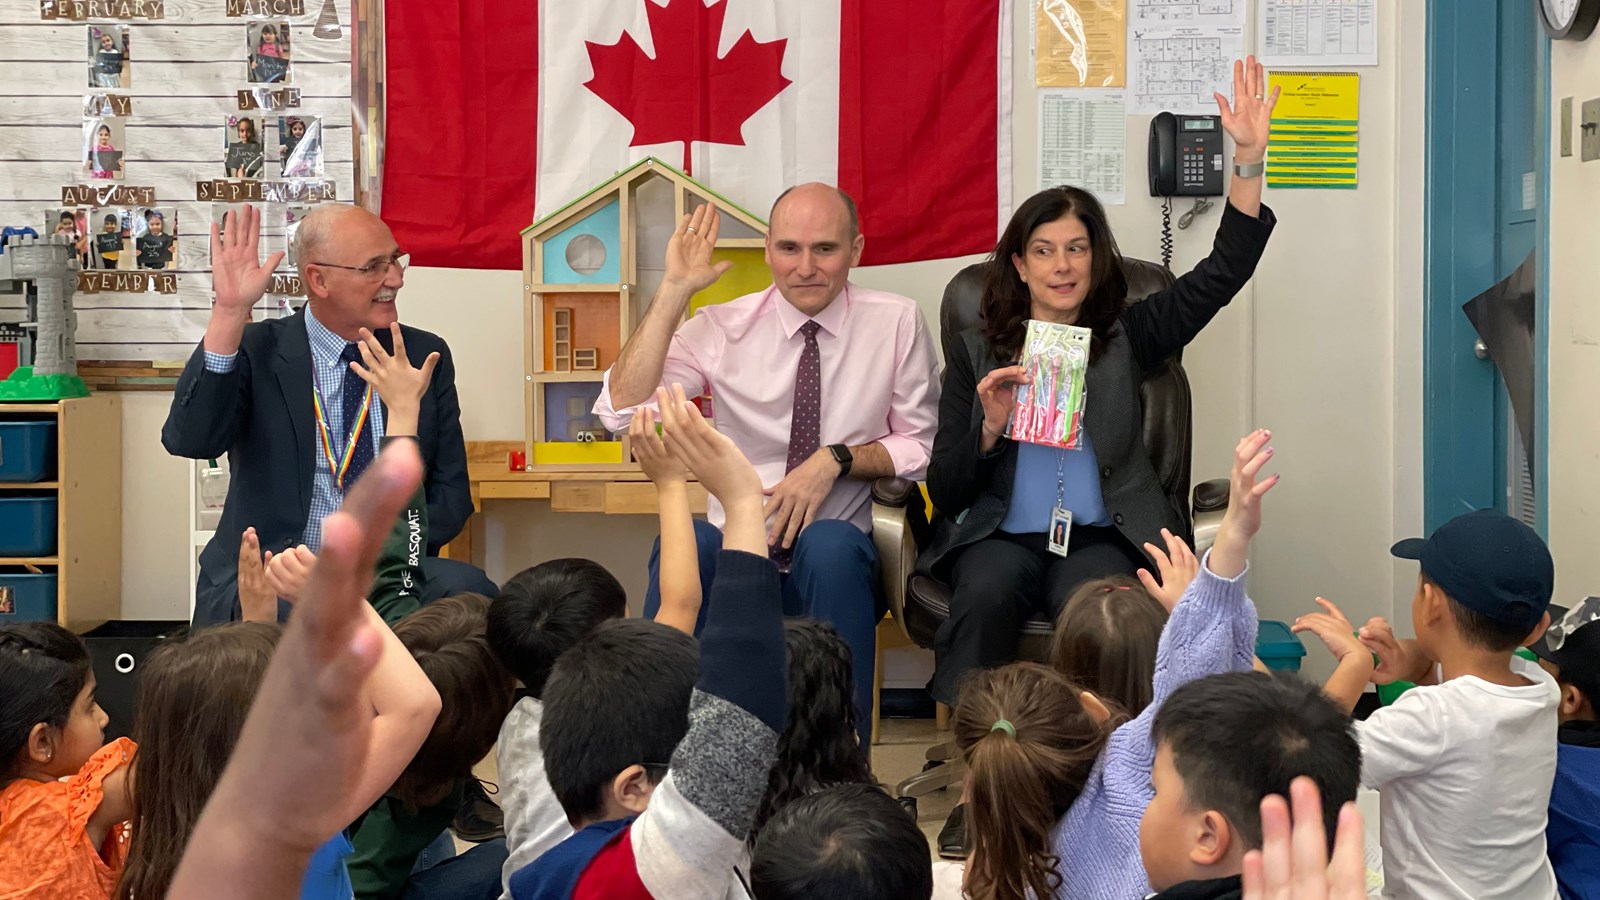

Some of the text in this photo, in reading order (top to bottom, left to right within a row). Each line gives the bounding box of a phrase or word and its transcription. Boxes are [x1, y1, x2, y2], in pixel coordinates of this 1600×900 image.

[41, 0, 162, 18] FEBRUARY
[226, 0, 300, 16] MARCH
[86, 96, 128, 115] MAY
[64, 187, 152, 204] AUGUST
[200, 182, 335, 200] SEPTEMBER
[76, 273, 176, 293] VEMBR
